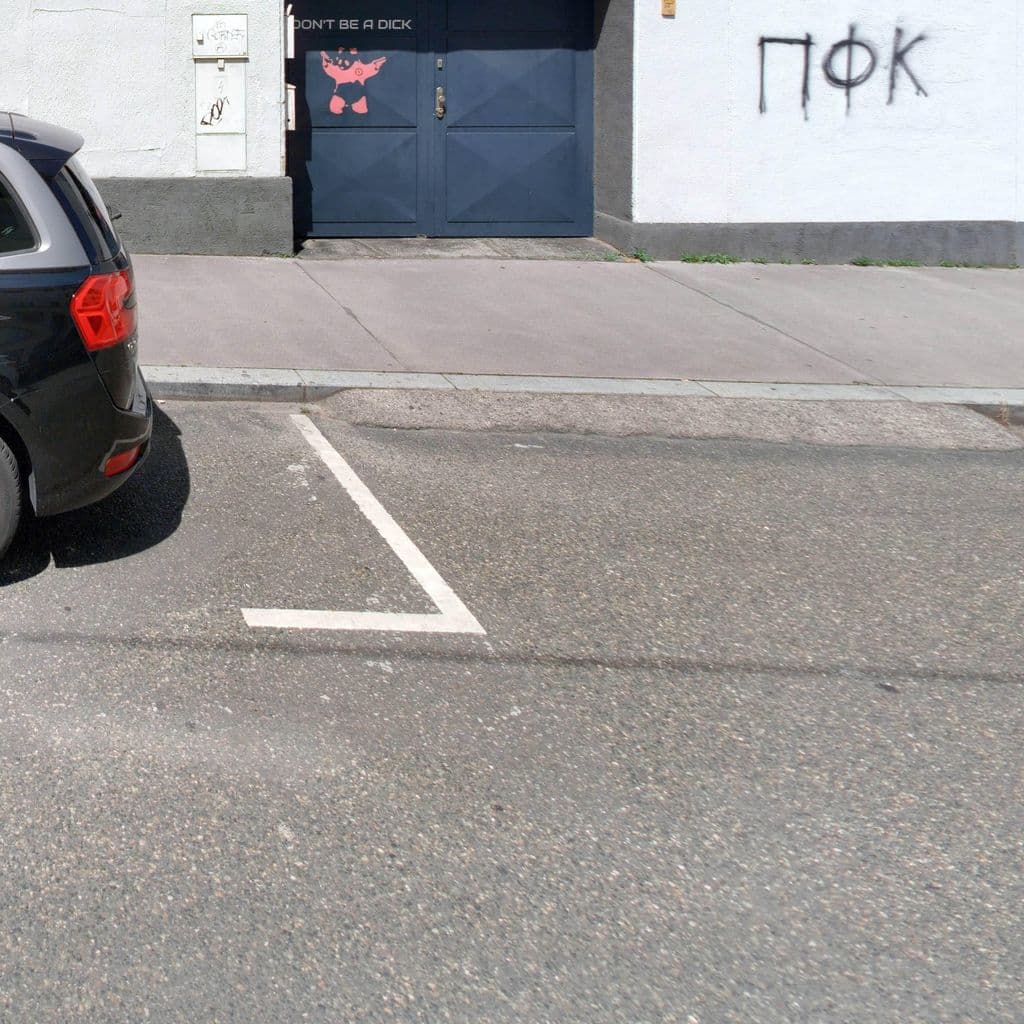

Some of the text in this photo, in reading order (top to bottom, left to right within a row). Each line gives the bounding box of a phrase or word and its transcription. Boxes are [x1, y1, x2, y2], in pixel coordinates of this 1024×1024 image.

[294, 19, 413, 30] DON'T BE A DICK
